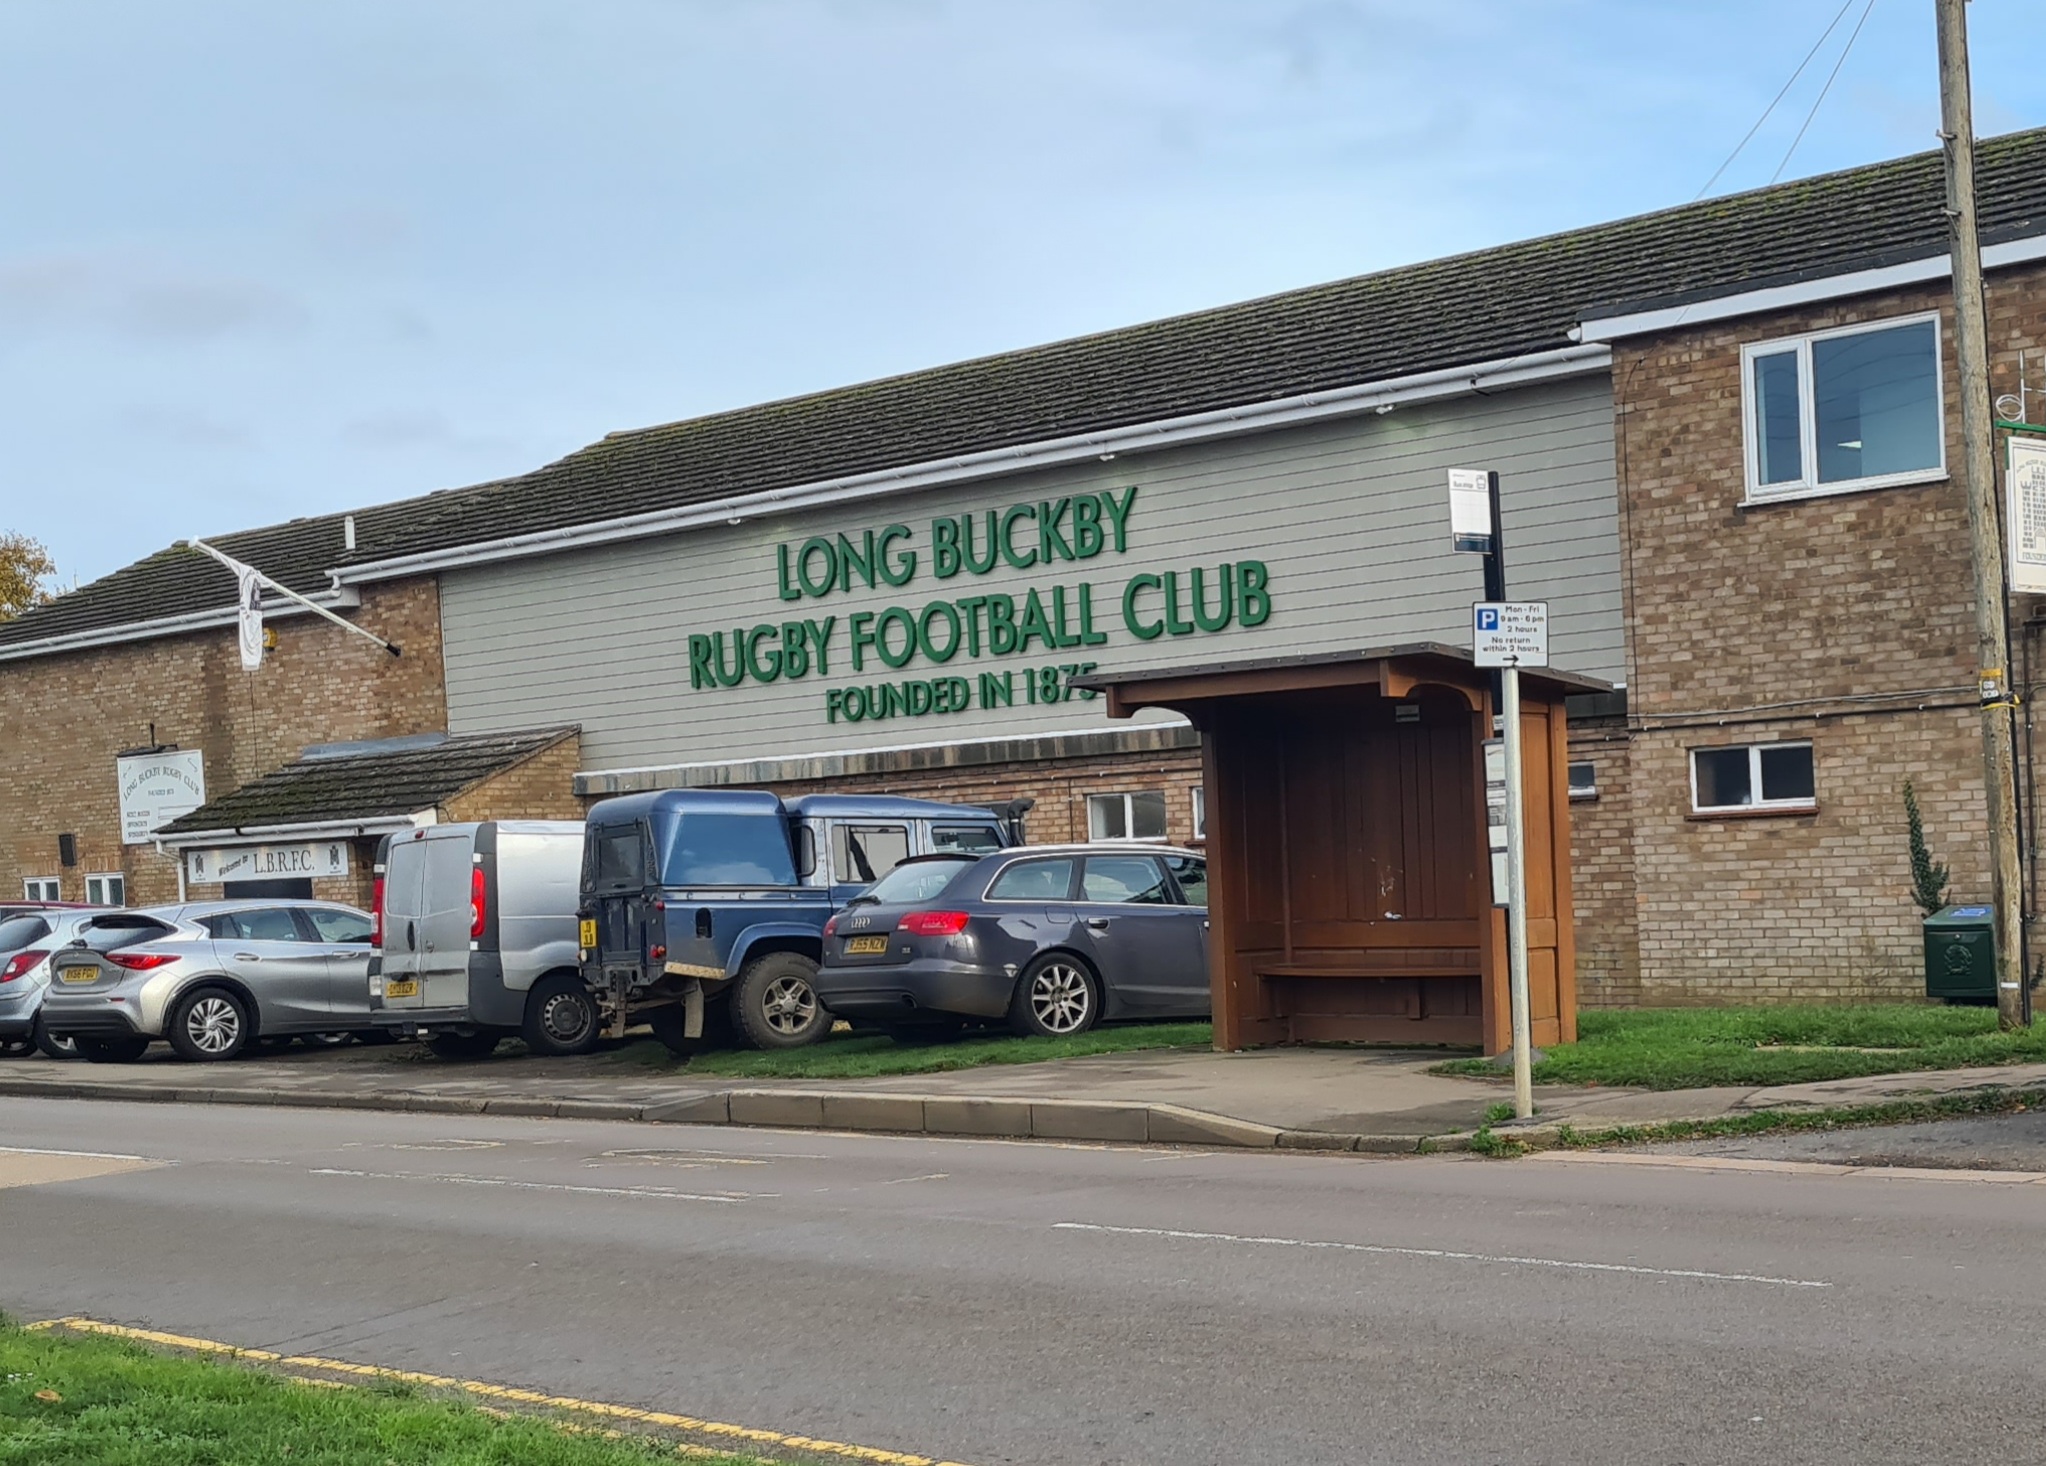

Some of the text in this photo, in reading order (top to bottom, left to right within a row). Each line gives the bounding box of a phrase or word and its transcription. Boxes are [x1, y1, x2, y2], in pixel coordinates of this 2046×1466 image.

[777, 487, 1138, 601] LONG BUCKBY
[688, 560, 1271, 690] RUGBY FOOTBALL CLUB
[1481, 611, 1496, 629] P
[1482, 645, 1507, 653] within
[1517, 645, 1540, 653] hours
[1491, 636, 1531, 644] No return
[826, 677, 969, 723] FOUNDED
[979, 670, 1012, 708] IN
[253, 849, 315, 874] L.B.R.F.C.
